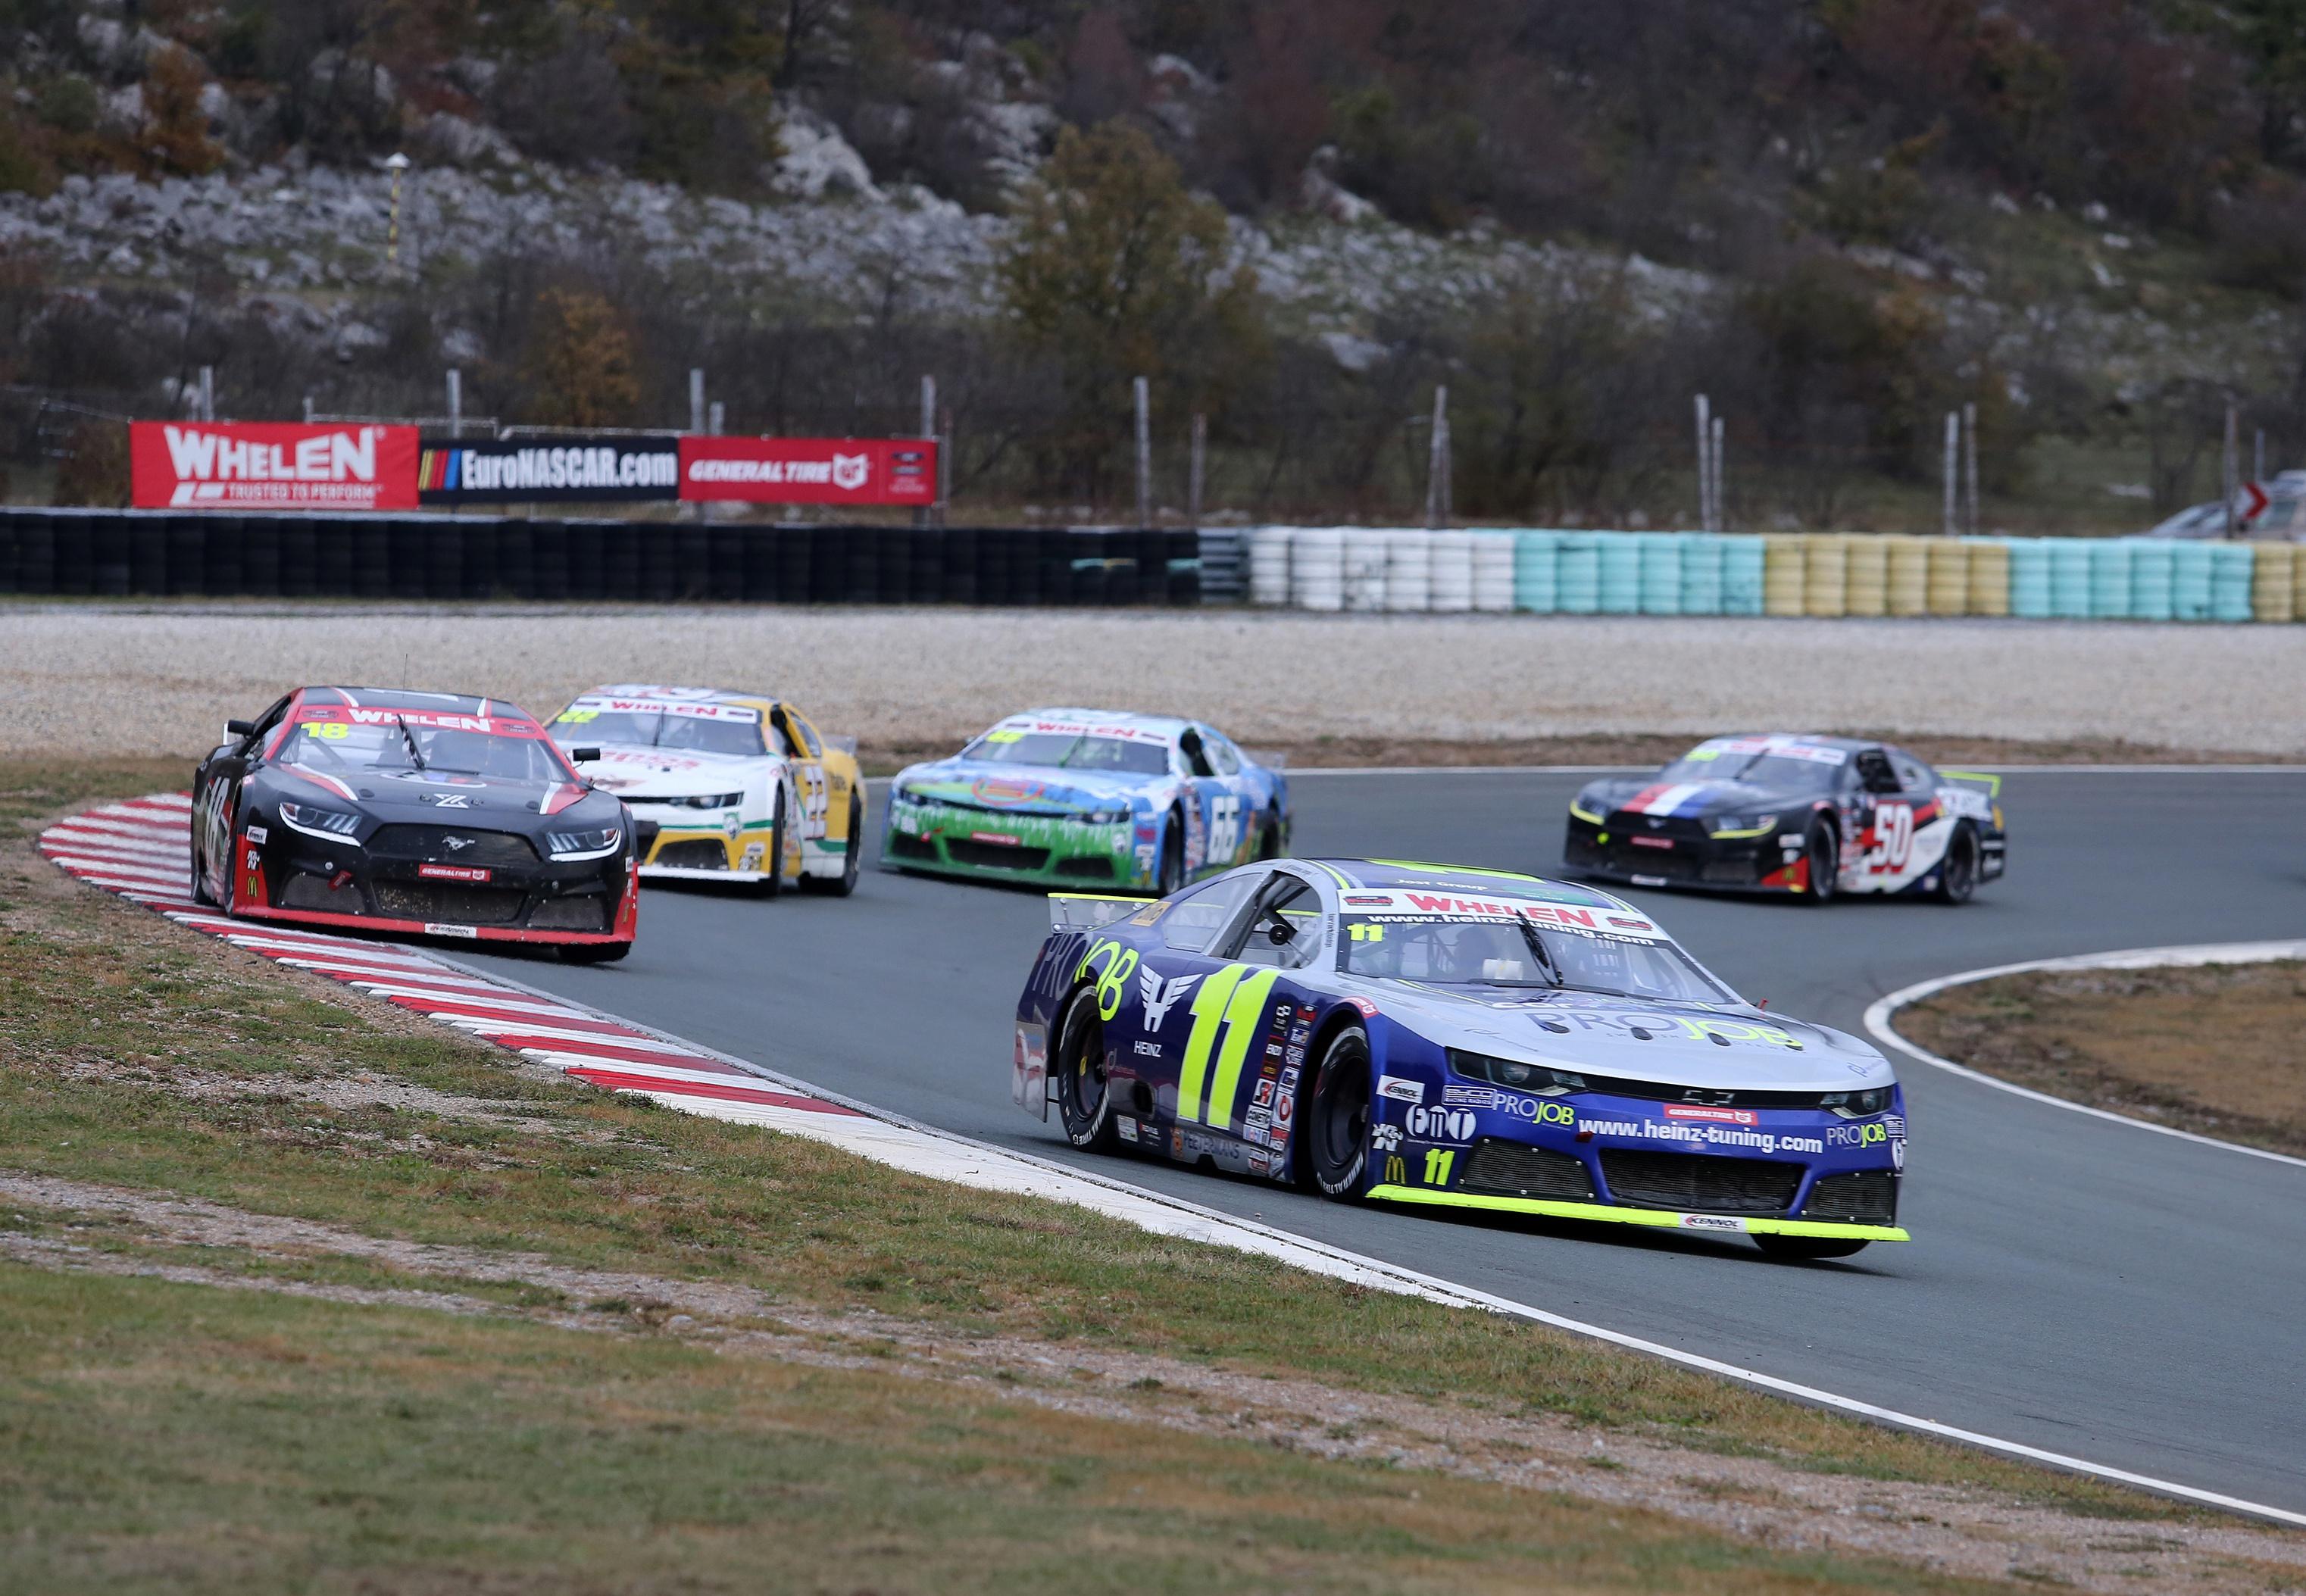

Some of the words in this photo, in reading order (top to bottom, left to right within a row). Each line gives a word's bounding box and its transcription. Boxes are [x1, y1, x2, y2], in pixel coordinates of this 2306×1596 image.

[163, 425, 375, 481] WHELEN
[461, 447, 678, 489] EuroNASCAR.com
[229, 483, 287, 499] TRUSTED
[311, 483, 375, 500] PERFORM
[300, 722, 348, 740] 18
[348, 708, 491, 732] WHELEN
[1870, 804, 1914, 873] 50
[1436, 881, 1488, 891] Group
[1405, 893, 1598, 928] WHELEN
[1346, 923, 1383, 942] 11
[1367, 914, 1656, 946] www.heinz-tuning.com
[1134, 1041, 1162, 1057] HEINZ
[1177, 962, 1282, 1129] 11
[1492, 1094, 1575, 1126] PROJOB
[1578, 1119, 1823, 1154] www.heinz-tuning.com
[1826, 1123, 1887, 1148] PROJOB
[1423, 1148, 1455, 1186] 11
